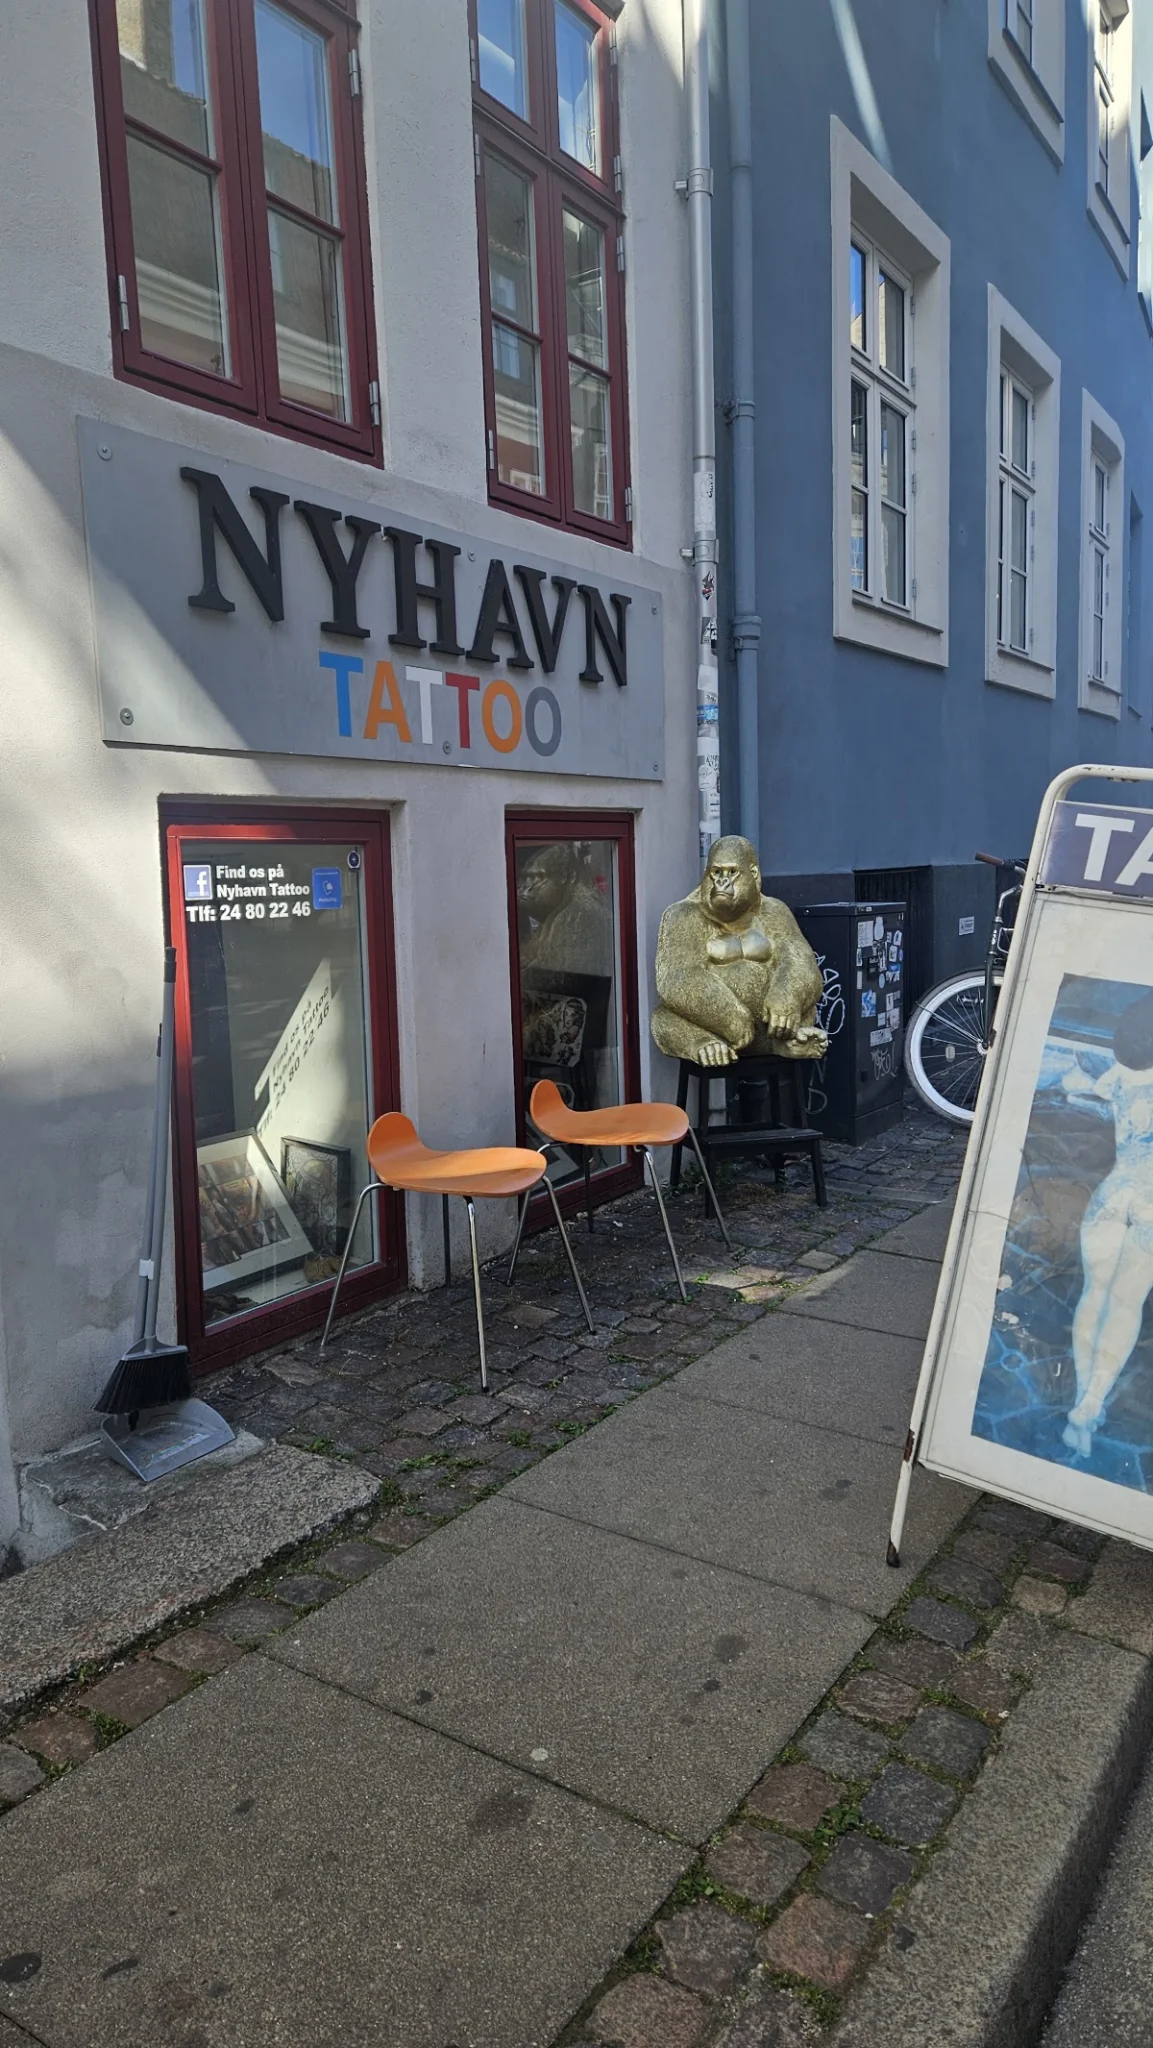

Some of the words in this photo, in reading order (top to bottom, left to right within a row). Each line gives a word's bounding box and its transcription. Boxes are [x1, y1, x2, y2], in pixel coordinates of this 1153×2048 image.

[180, 466, 632, 687] NYHAVN
[318, 650, 562, 757] TATTOO
[216, 865, 246, 879] Find
[249, 867, 265, 879] os
[268, 863, 285, 881] på
[216, 884, 267, 901] Nyhavn
[269, 882, 310, 897] Tattoo
[186, 904, 216, 923] Tlf:
[220, 903, 242, 921] 24
[245, 902, 265, 920] 80
[269, 901, 289, 919] 22
[292, 900, 311, 917] 46
